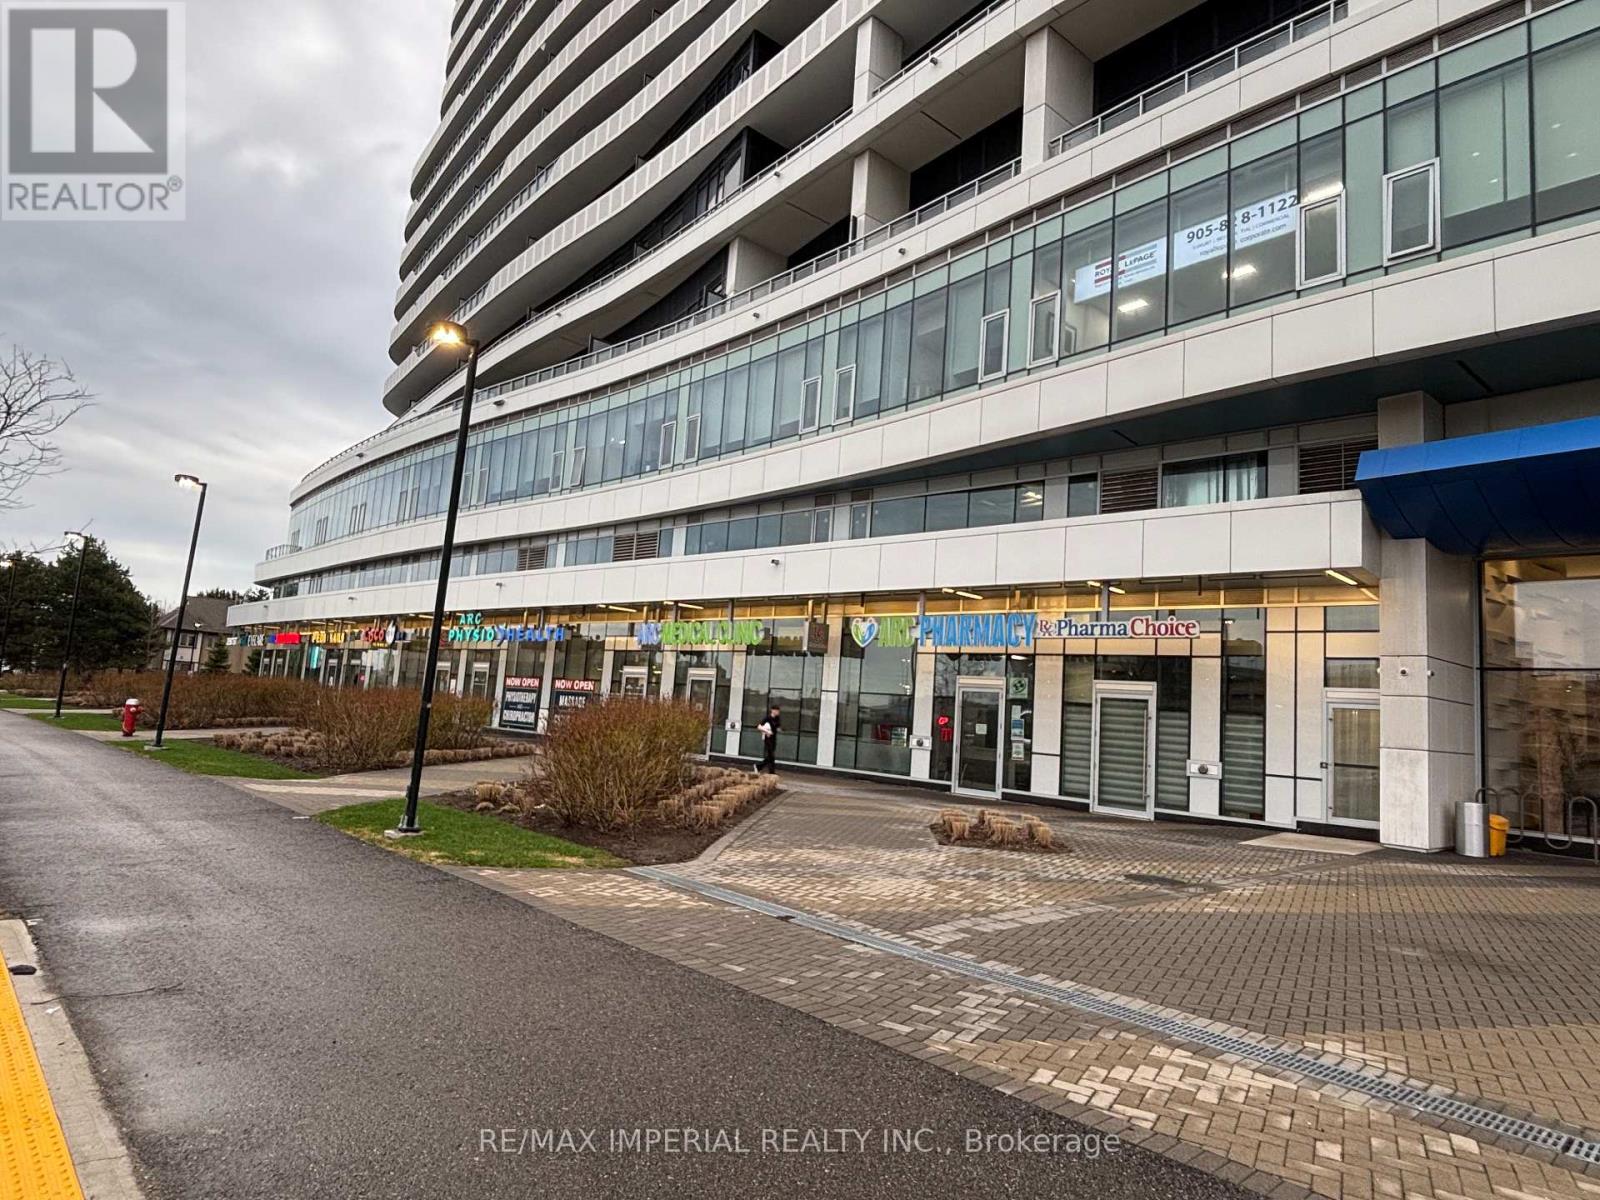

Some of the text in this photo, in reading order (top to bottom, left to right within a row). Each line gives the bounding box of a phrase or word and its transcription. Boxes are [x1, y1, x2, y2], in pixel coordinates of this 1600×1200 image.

[1186, 194, 1298, 243] 905-88-1122
[460, 612, 483, 625] ARC
[1056, 617, 1197, 637] PharmaChoice
[448, 627, 495, 641] PHYSIO
[718, 620, 765, 646] CLINIC
[877, 612, 1036, 648] ARC PHARMACY
[506, 677, 539, 687] NOW OPEN
[555, 680, 595, 690] NOW OPEN
